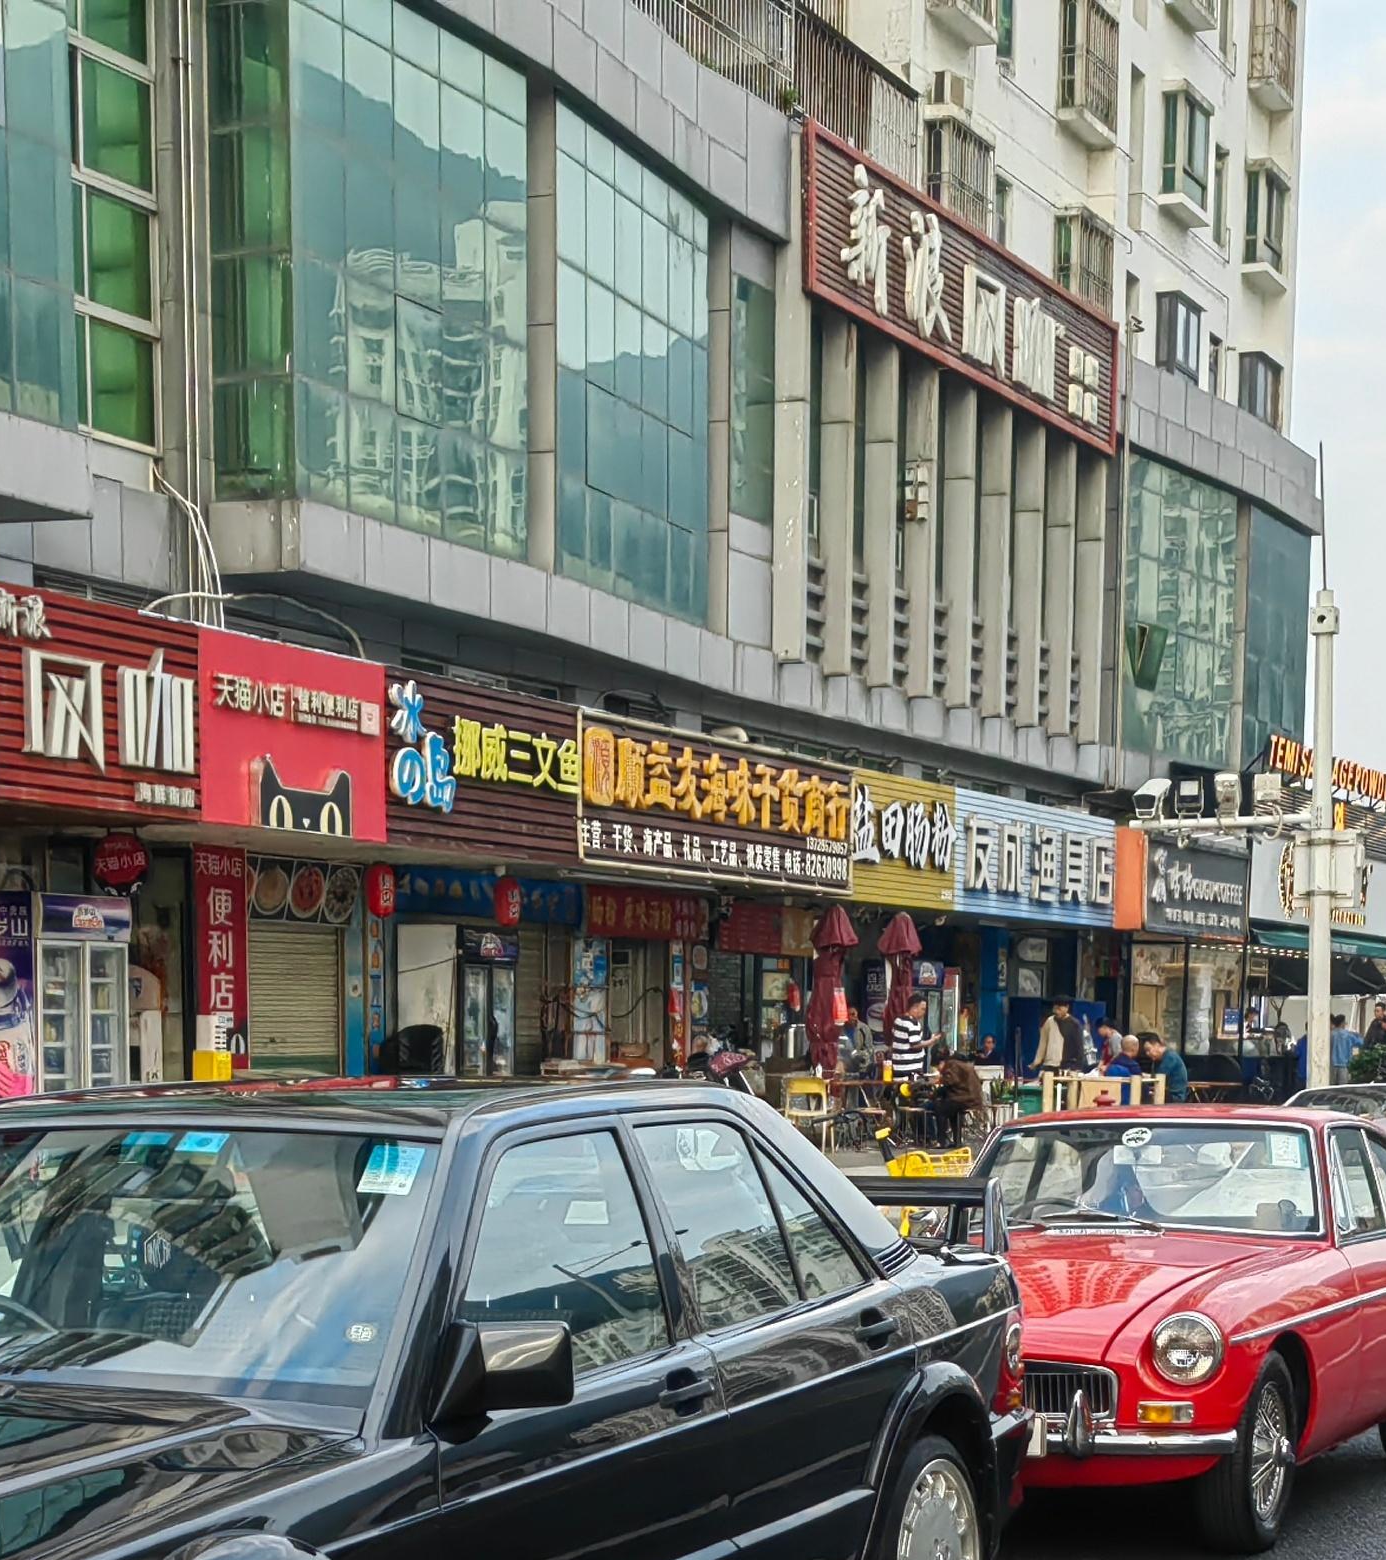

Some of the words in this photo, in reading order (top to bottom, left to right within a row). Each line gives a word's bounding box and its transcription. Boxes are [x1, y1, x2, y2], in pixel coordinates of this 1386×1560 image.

[23, 647, 195, 775] 网咖
[215, 672, 286, 718] 天猫小店
[453, 715, 580, 794] 挪威三文鱼
[195, 852, 243, 878] 天猫小店
[853, 784, 957, 872] 盐田肠粉
[965, 813, 1114, 905] 友成渔具店
[206, 886, 235, 1010] 便利店
